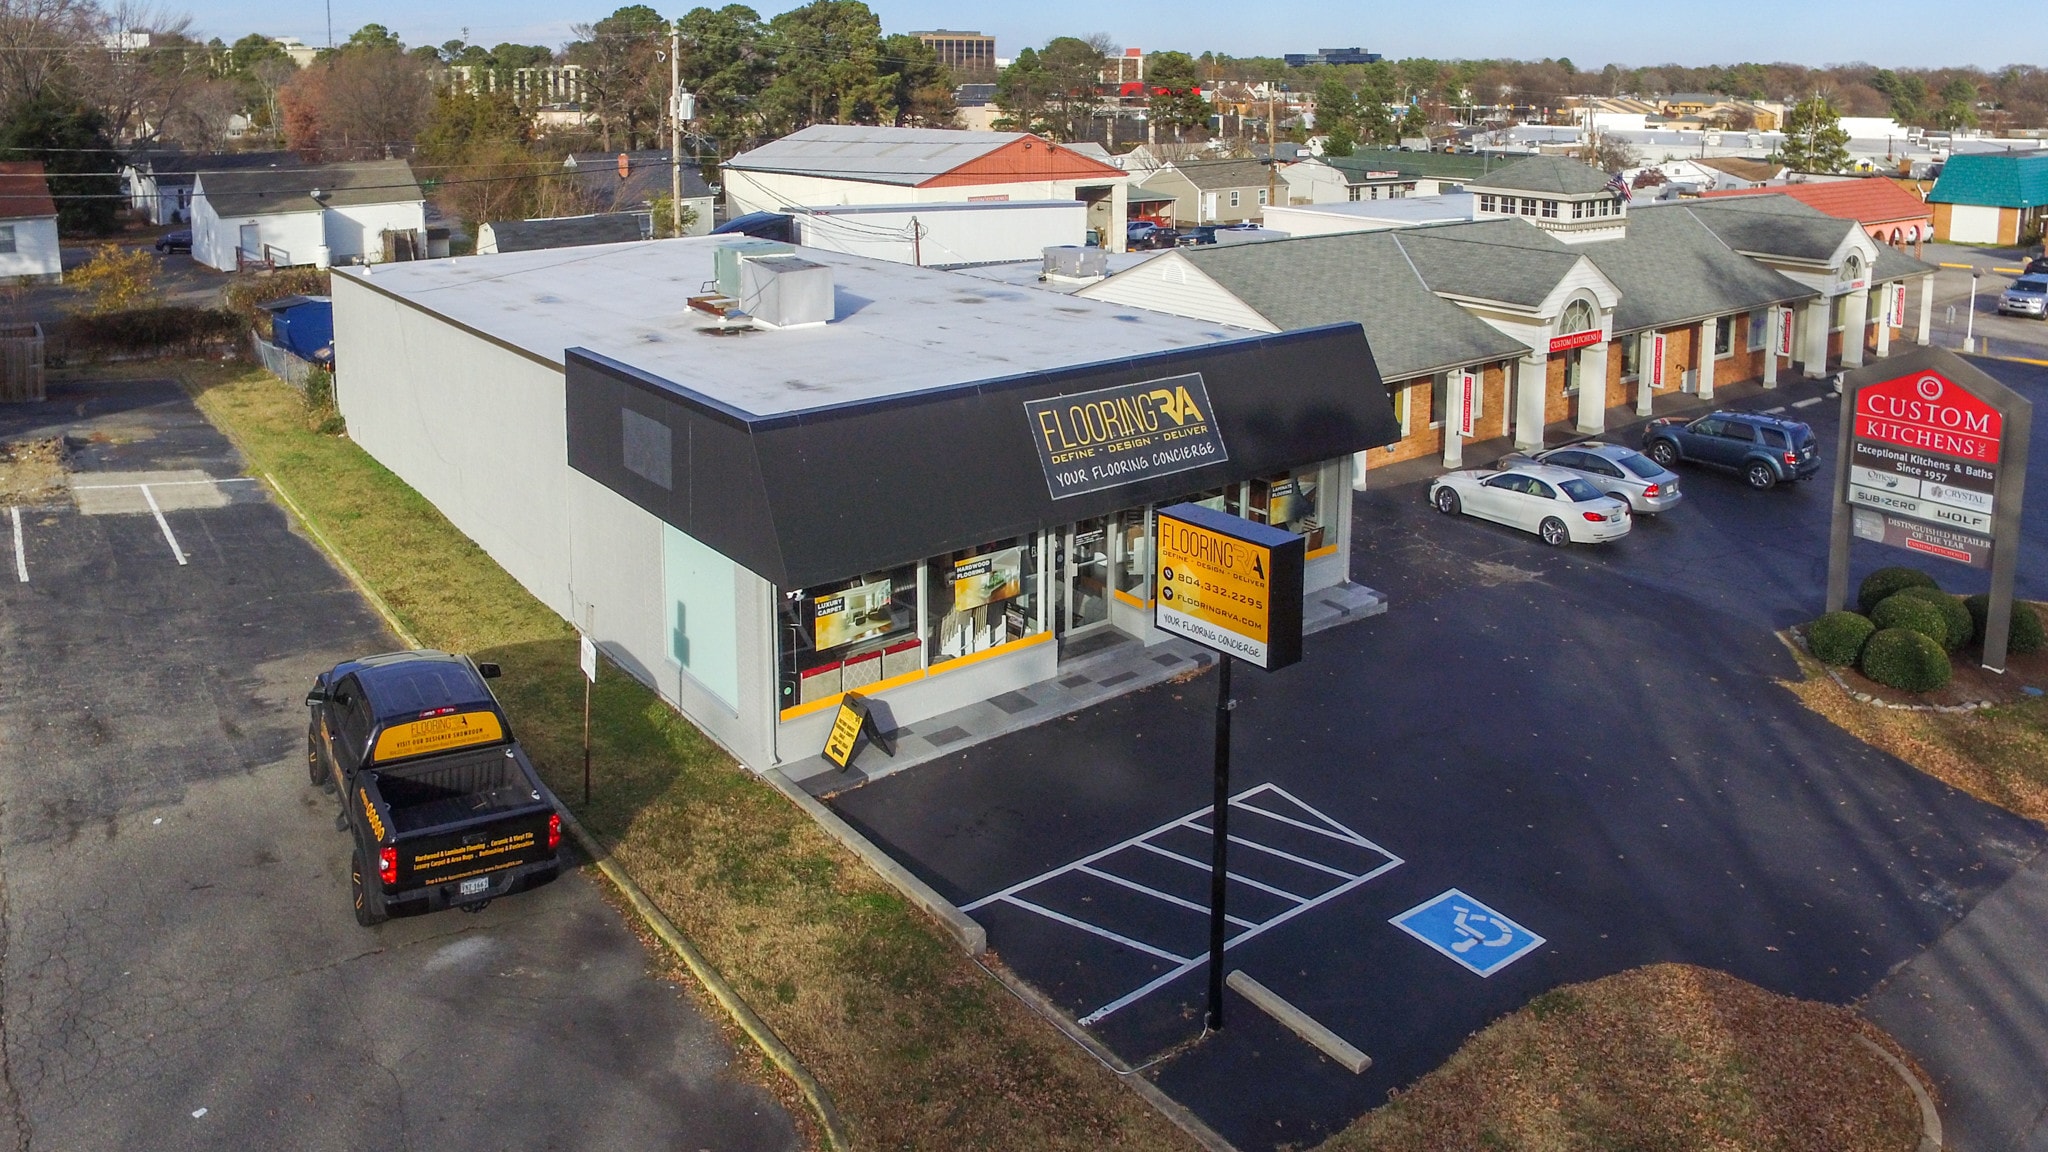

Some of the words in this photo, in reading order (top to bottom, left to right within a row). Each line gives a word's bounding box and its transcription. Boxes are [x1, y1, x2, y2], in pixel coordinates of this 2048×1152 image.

[1550, 338, 1572, 349] CUSTOM
[1867, 393, 1990, 434] CUSTOM
[1052, 448, 1095, 464] DEFINE
[1108, 437, 1151, 453] DESIGN
[1163, 425, 1208, 441] DELIVER
[1866, 420, 1975, 456] KITCHENS
[1056, 468, 1089, 488] YOUR
[1091, 458, 1150, 480] FLOORING
[1152, 441, 1215, 466] CONCIERGE
[1857, 443, 1908, 462] Exceptional
[1910, 454, 1950, 471] Kitchens
[1954, 464, 1962, 473] &
[1965, 465, 1994, 480] Baths
[1896, 462, 1921, 476] Since
[1924, 469, 1948, 482] 1957
[1944, 488, 1986, 504] CRYSTAL
[1937, 508, 1982, 525] WOLF
[1888, 517, 1951, 539] DISTINGUISHED
[1952, 533, 1992, 549] RETAILER
[1912, 530, 1924, 540] OF
[1925, 534, 1941, 544] THE
[1943, 538, 1965, 550] YEAR
[956, 560, 990, 573] HARDWOOD
[956, 568, 985, 579] FLOORING
[1162, 550, 1189, 563] DEFINE
[1197, 561, 1225, 575] DESIGN
[1233, 573, 1265, 589] DELIVER
[817, 598, 842, 610] LUXURY
[1177, 573, 1264, 610] 804.332.2295
[817, 605, 842, 616] CARPET
[1177, 594, 1262, 631] FLOORINGRVA.COM
[1163, 613, 1181, 628] YOUR
[1182, 620, 1217, 641] FLOORING
[1217, 634, 1261, 658] CONCIERGE
[397, 740, 411, 748] VISIT
[453, 727, 483, 738] SHOWROOM
